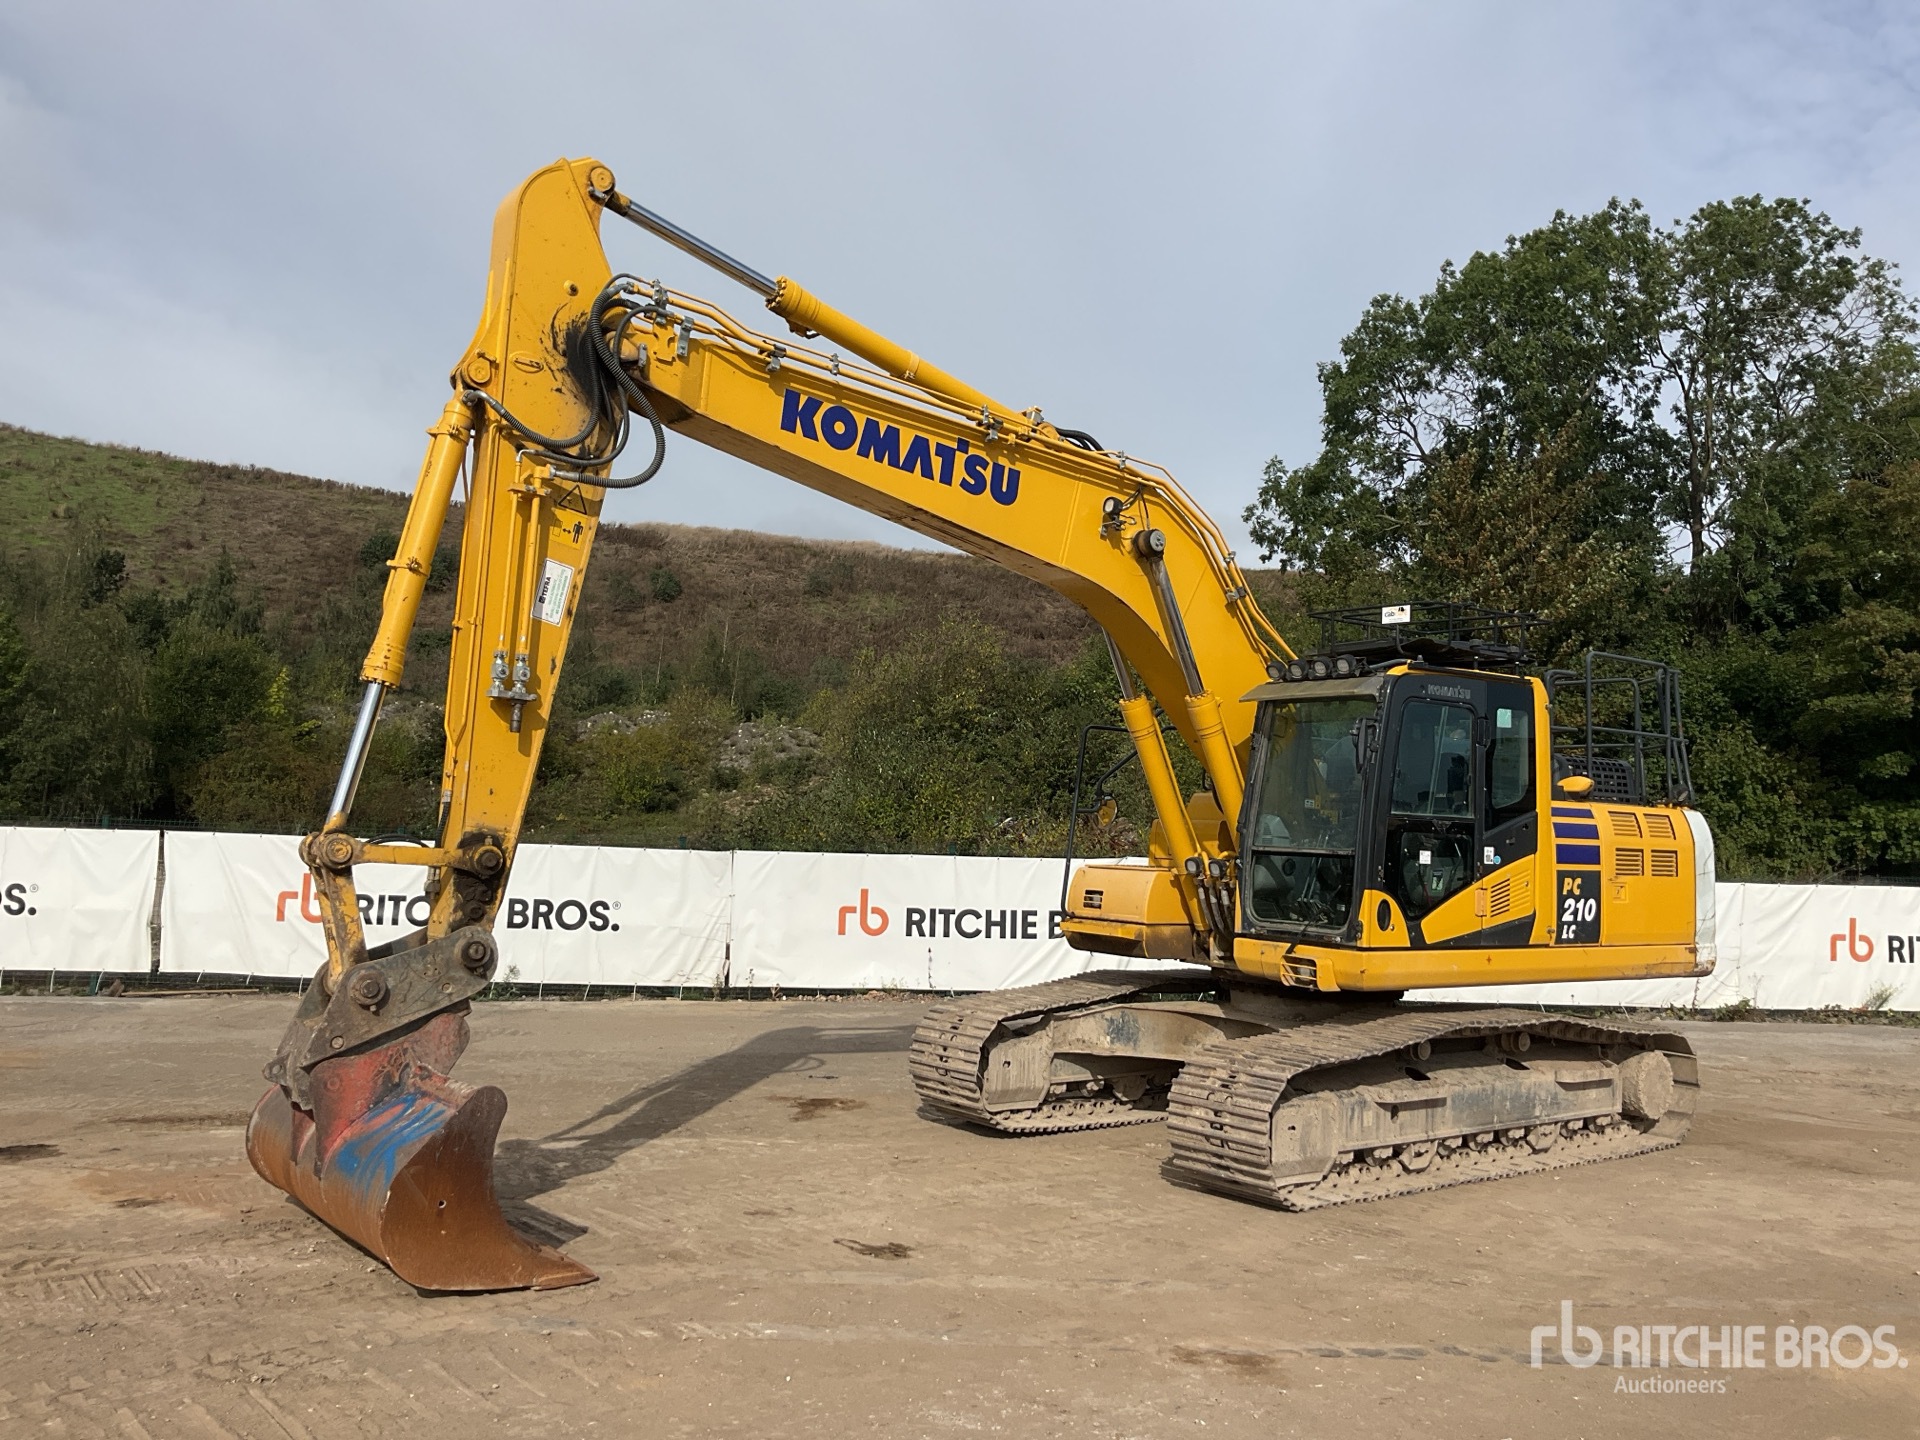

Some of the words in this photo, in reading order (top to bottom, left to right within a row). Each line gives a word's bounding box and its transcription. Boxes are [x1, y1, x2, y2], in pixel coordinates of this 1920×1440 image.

[780, 388, 1021, 506] KOMATSU
[1427, 684, 1471, 699] KOMATSU
[1563, 878, 1582, 895] PC
[837, 888, 889, 936] rb
[905, 907, 1038, 939] RITCHIE
[1562, 898, 1597, 921] 210
[1561, 924, 1576, 939] LC
[1830, 917, 1874, 962] rb
